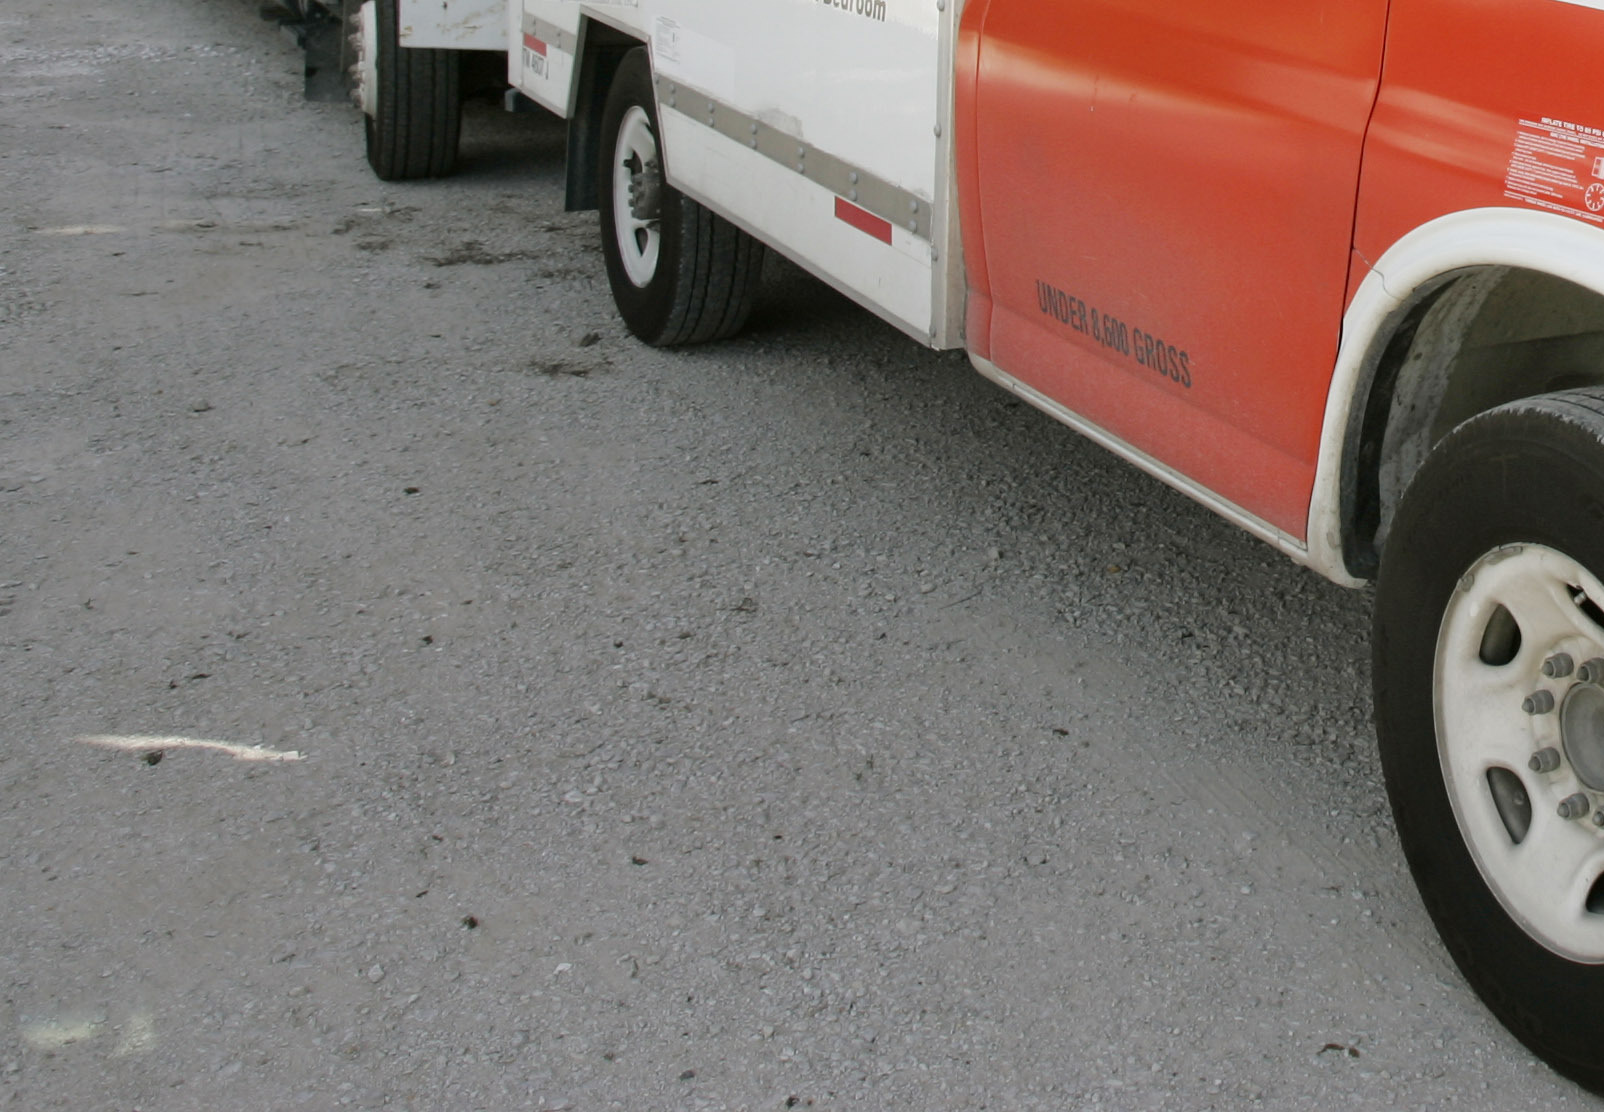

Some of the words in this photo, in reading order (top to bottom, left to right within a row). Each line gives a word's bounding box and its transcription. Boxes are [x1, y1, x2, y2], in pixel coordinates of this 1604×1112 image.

[1035, 279, 1090, 336] UNDER
[1091, 307, 1130, 357] 8,600
[1133, 327, 1192, 388] GROSS
